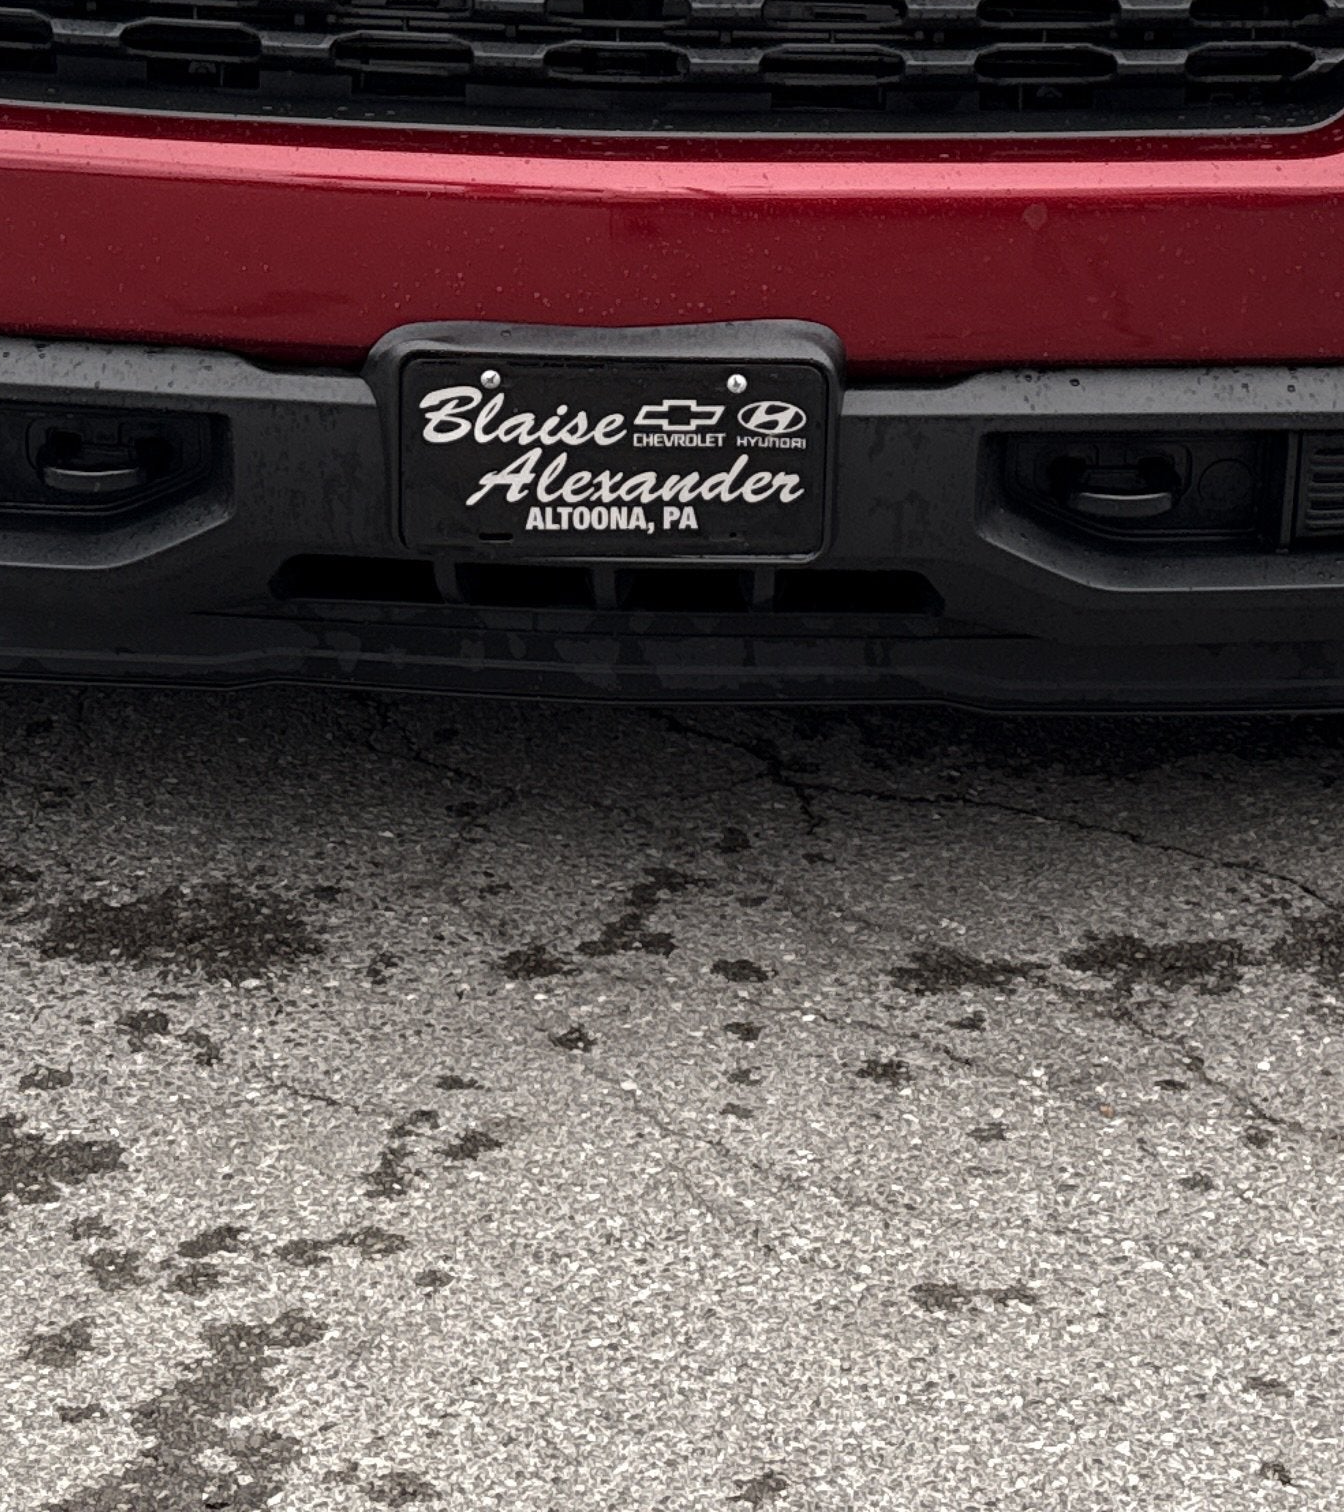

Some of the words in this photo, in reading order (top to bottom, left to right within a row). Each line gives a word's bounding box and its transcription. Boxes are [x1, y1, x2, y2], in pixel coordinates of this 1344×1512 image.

[419, 386, 627, 446] Blaise
[633, 432, 726, 448] CHEVROLET
[736, 436, 807, 450] HYUNDAI
[465, 447, 805, 506] Alexander
[525, 506, 655, 535] ALTOONA,
[662, 506, 699, 530] PA
